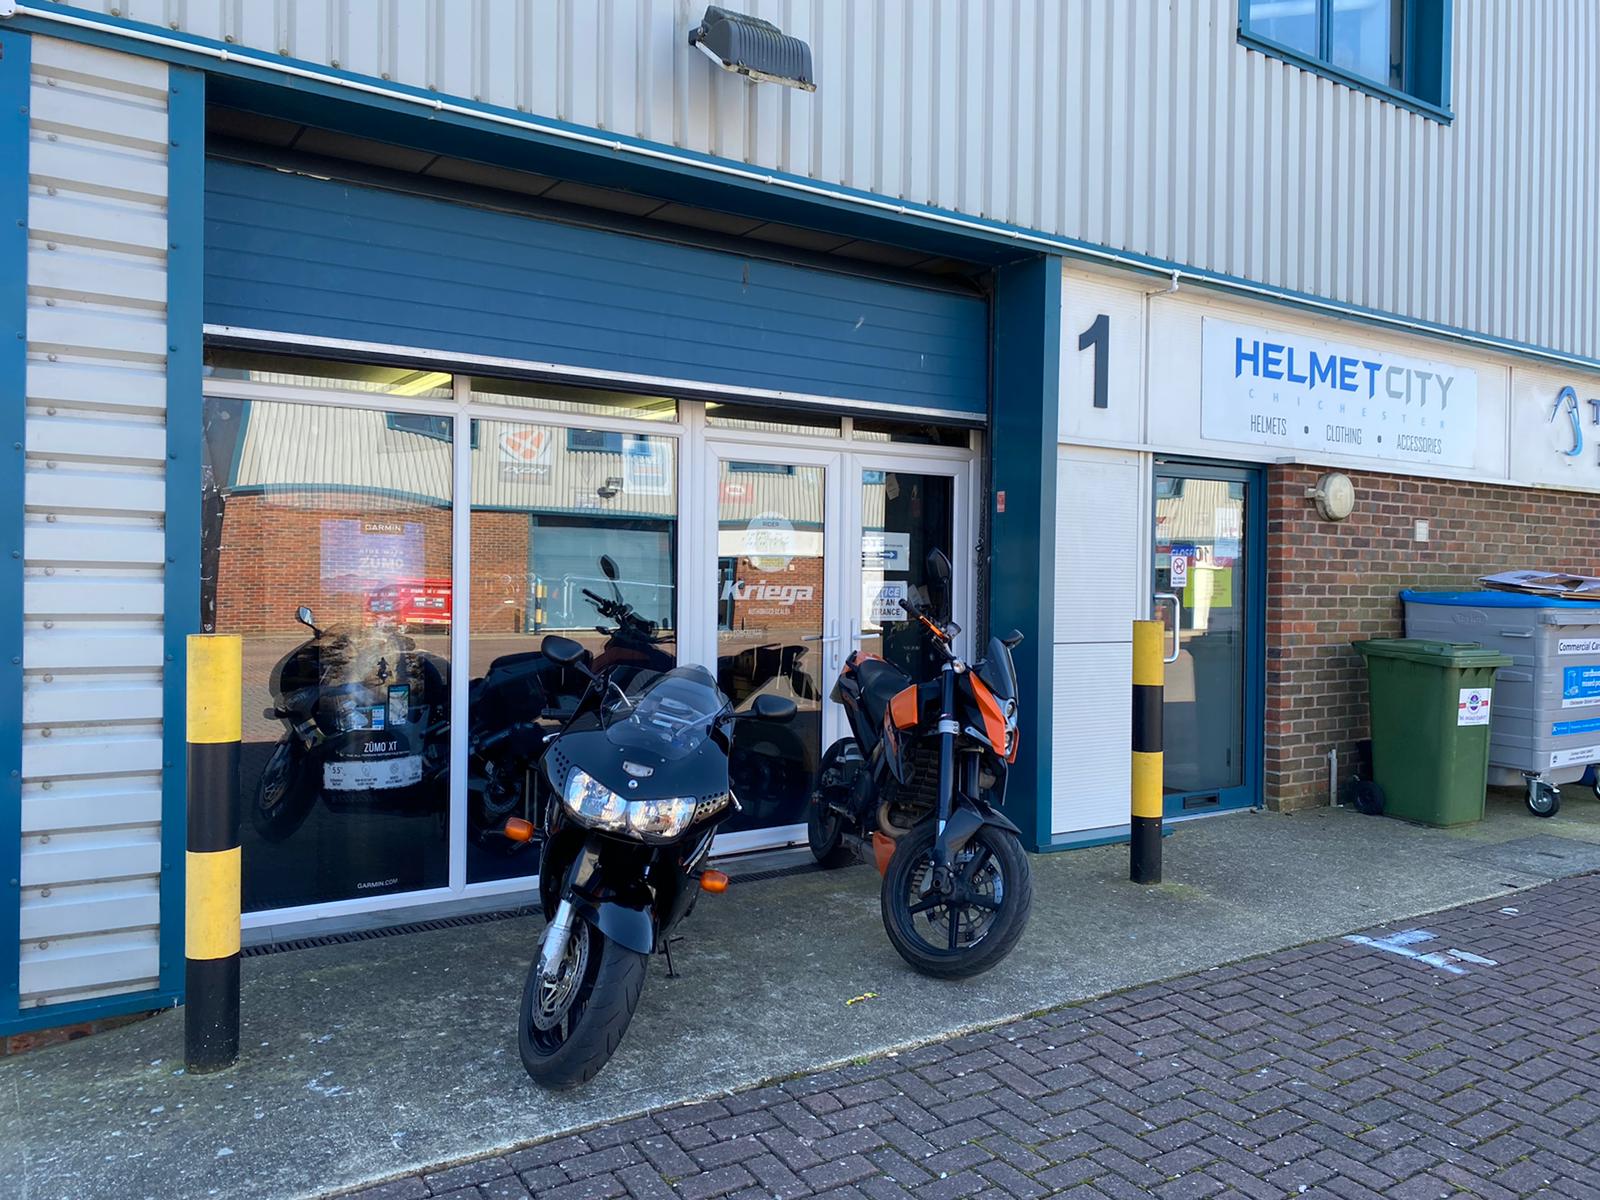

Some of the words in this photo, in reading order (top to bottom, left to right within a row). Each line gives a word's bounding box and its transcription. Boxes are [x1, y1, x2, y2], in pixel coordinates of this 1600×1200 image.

[1078, 313, 1110, 409] 1
[1248, 388, 1445, 429] CHICHESTER
[1250, 414, 1287, 436] HELMETS
[1326, 424, 1362, 445] CLOTHING
[1396, 434, 1442, 455] ACCESSORIES
[364, 524, 401, 532] GARMIN
[720, 579, 814, 606] Kriega
[867, 586, 901, 598] TICE
[885, 599, 896, 607] AN
[870, 607, 901, 616] TRANCE
[1559, 641, 1591, 651] Commercial
[388, 741, 397, 751] XT
[357, 878, 398, 889] GARMIN.COM
